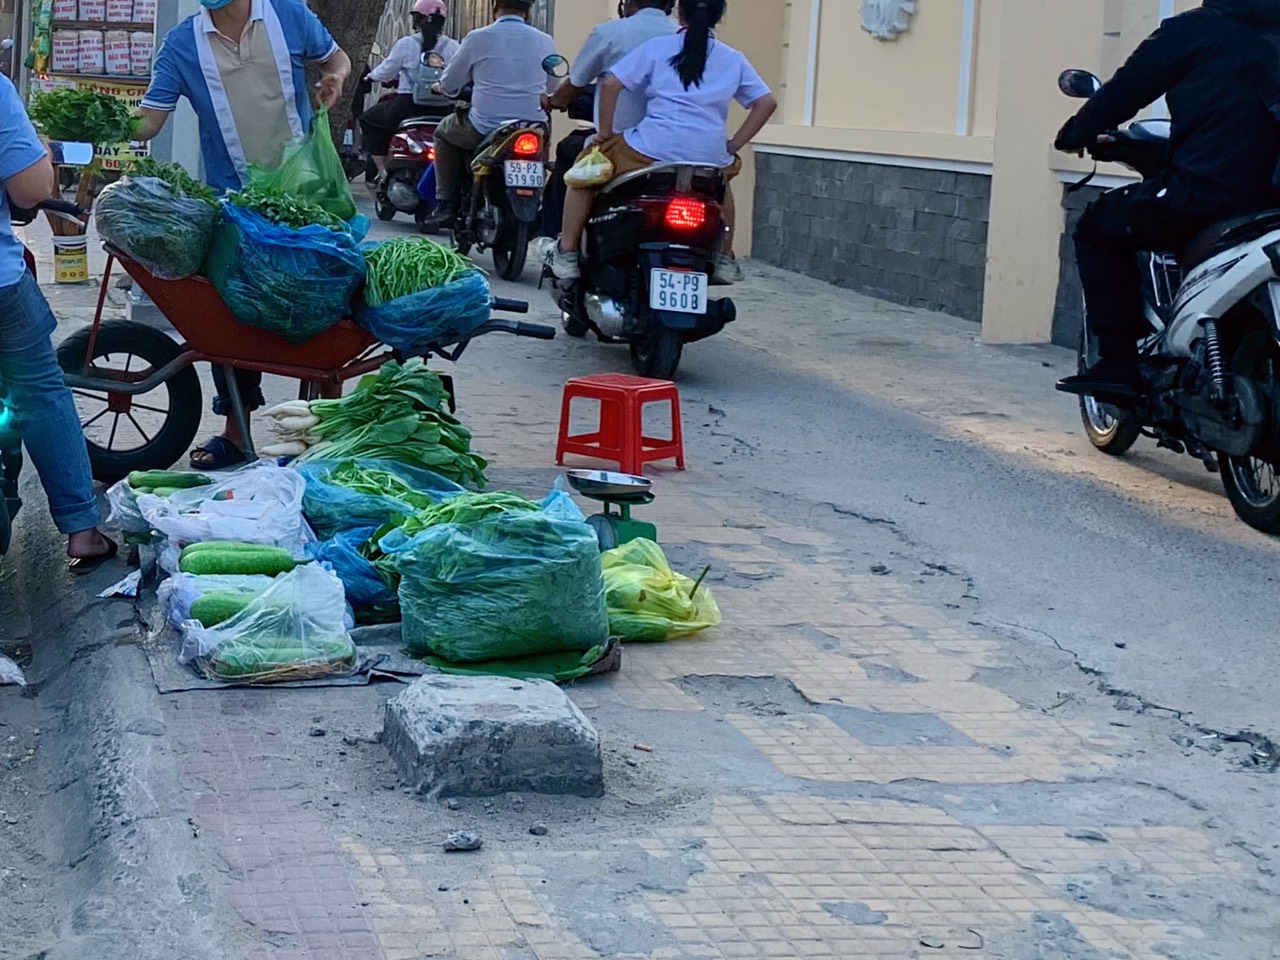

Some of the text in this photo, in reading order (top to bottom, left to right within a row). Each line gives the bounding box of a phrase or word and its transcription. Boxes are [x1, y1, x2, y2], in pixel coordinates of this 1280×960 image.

[510, 162, 538, 174] 59-P2
[508, 173, 542, 186] 519.90
[660, 272, 699, 291] 54-P9
[659, 290, 699, 310] 9608
